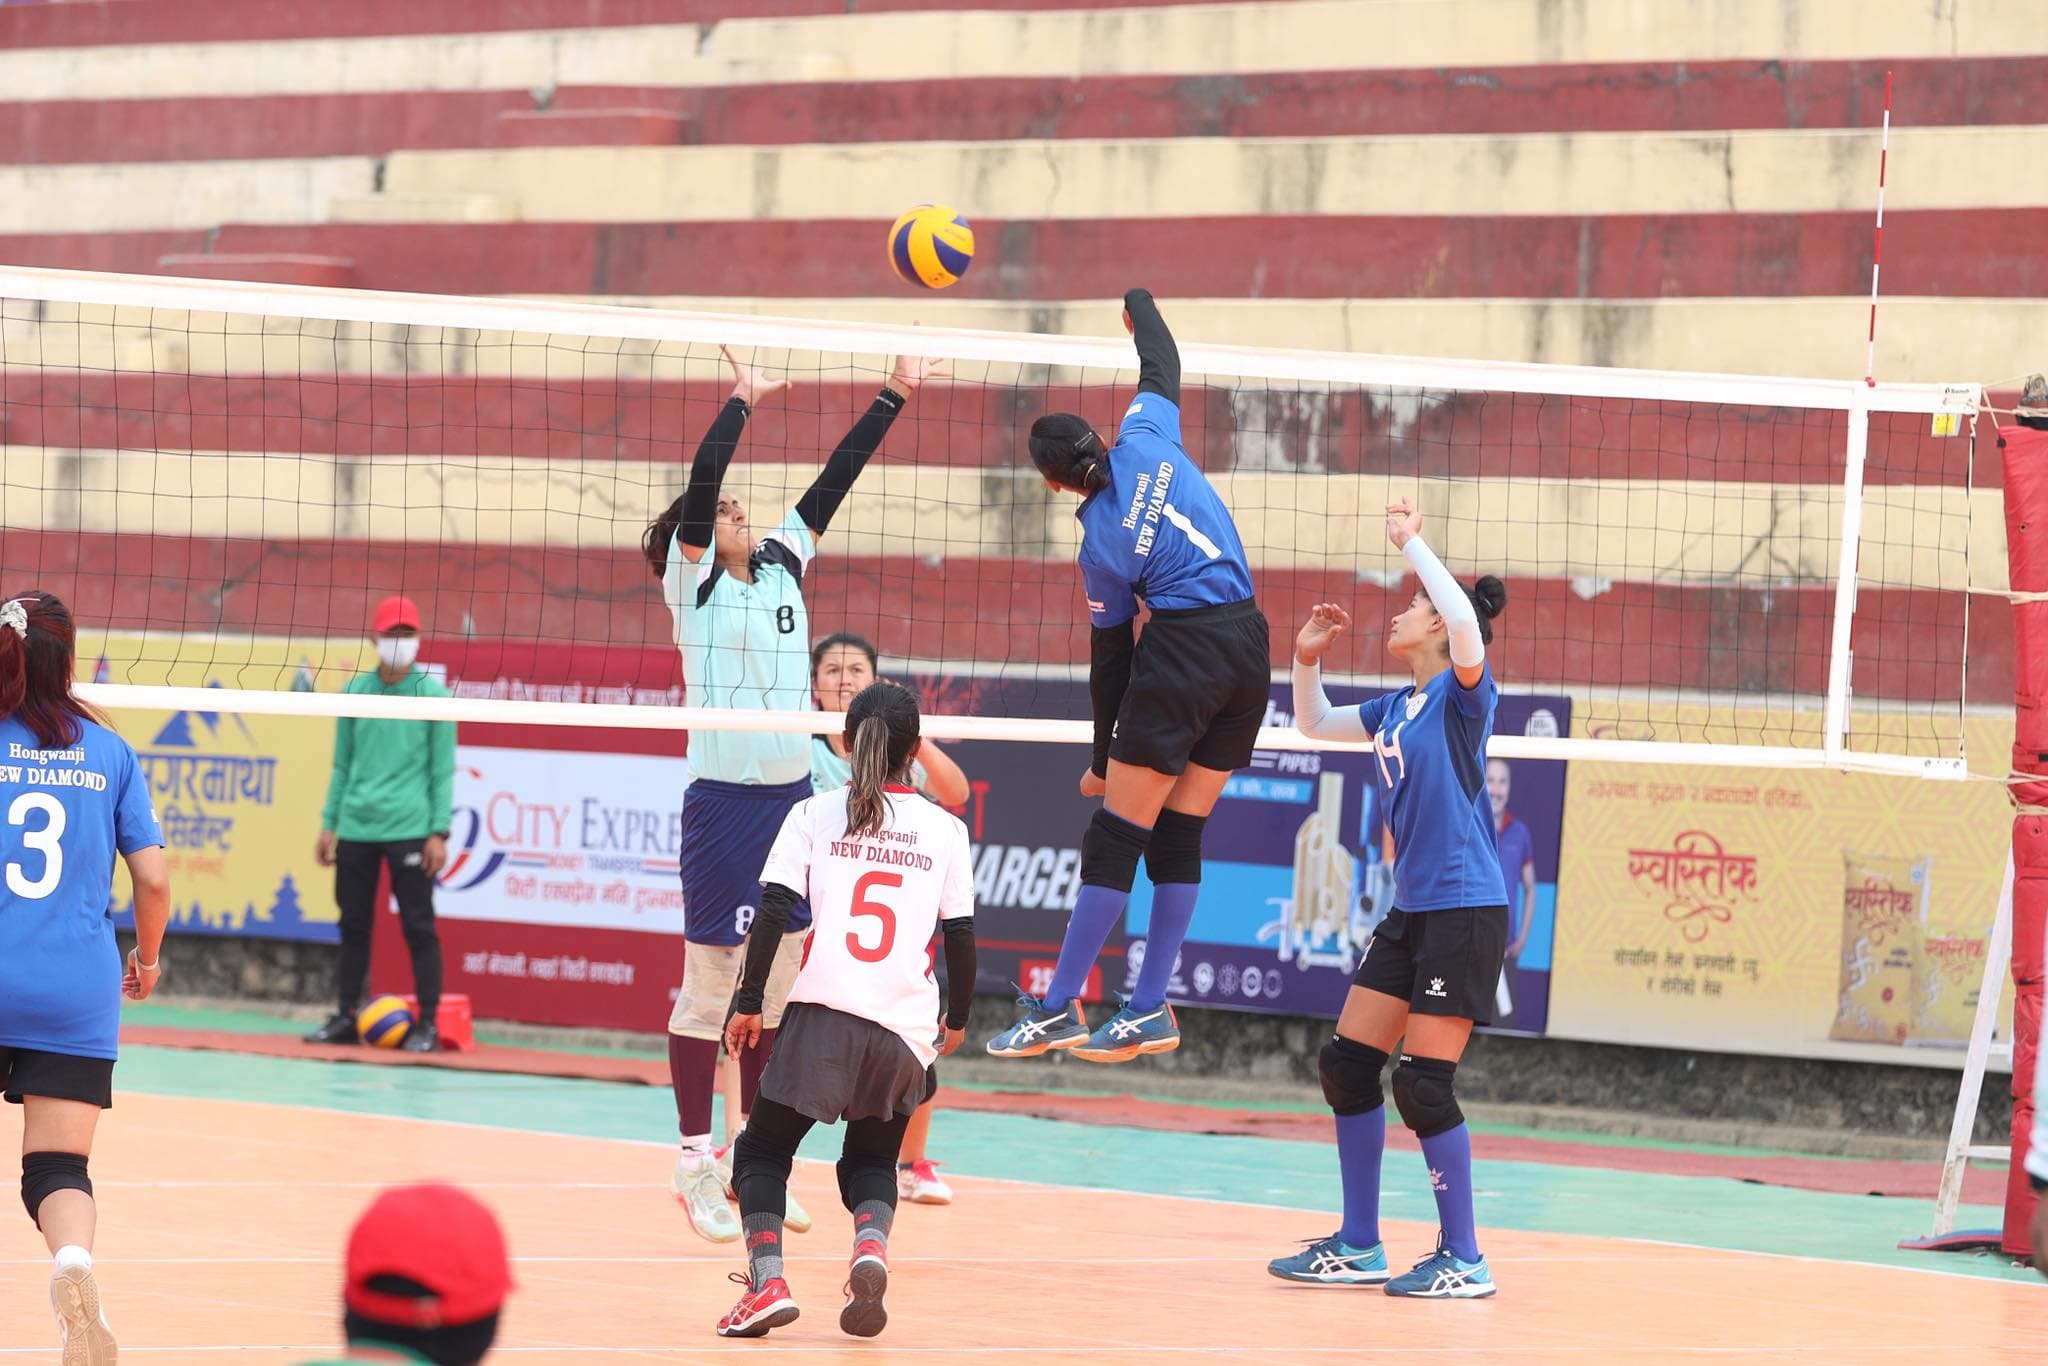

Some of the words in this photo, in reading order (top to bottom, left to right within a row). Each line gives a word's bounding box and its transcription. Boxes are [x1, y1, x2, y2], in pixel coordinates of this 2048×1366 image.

[1122, 472, 1152, 530] Hongwanji
[1134, 522, 1154, 558] NEW
[1145, 460, 1175, 525] DIAMOND
[1162, 502, 1223, 560] 1
[776, 604, 795, 634] 8
[0, 766, 23, 785] EW
[27, 768, 107, 792] DIAMOND
[9, 743, 86, 765] Hongwanji
[1277, 752, 1322, 775] PIPES
[1374, 720, 1406, 789] 14
[6, 791, 67, 900] 3
[487, 790, 571, 850] CITY
[579, 796, 682, 856] EXPRE
[829, 841, 864, 860] NEW
[866, 846, 933, 872] DIAMOND
[971, 843, 1082, 911] ARGE
[735, 905, 756, 936] 8
[846, 870, 904, 963] 5
[1425, 989, 1448, 997] KELME
